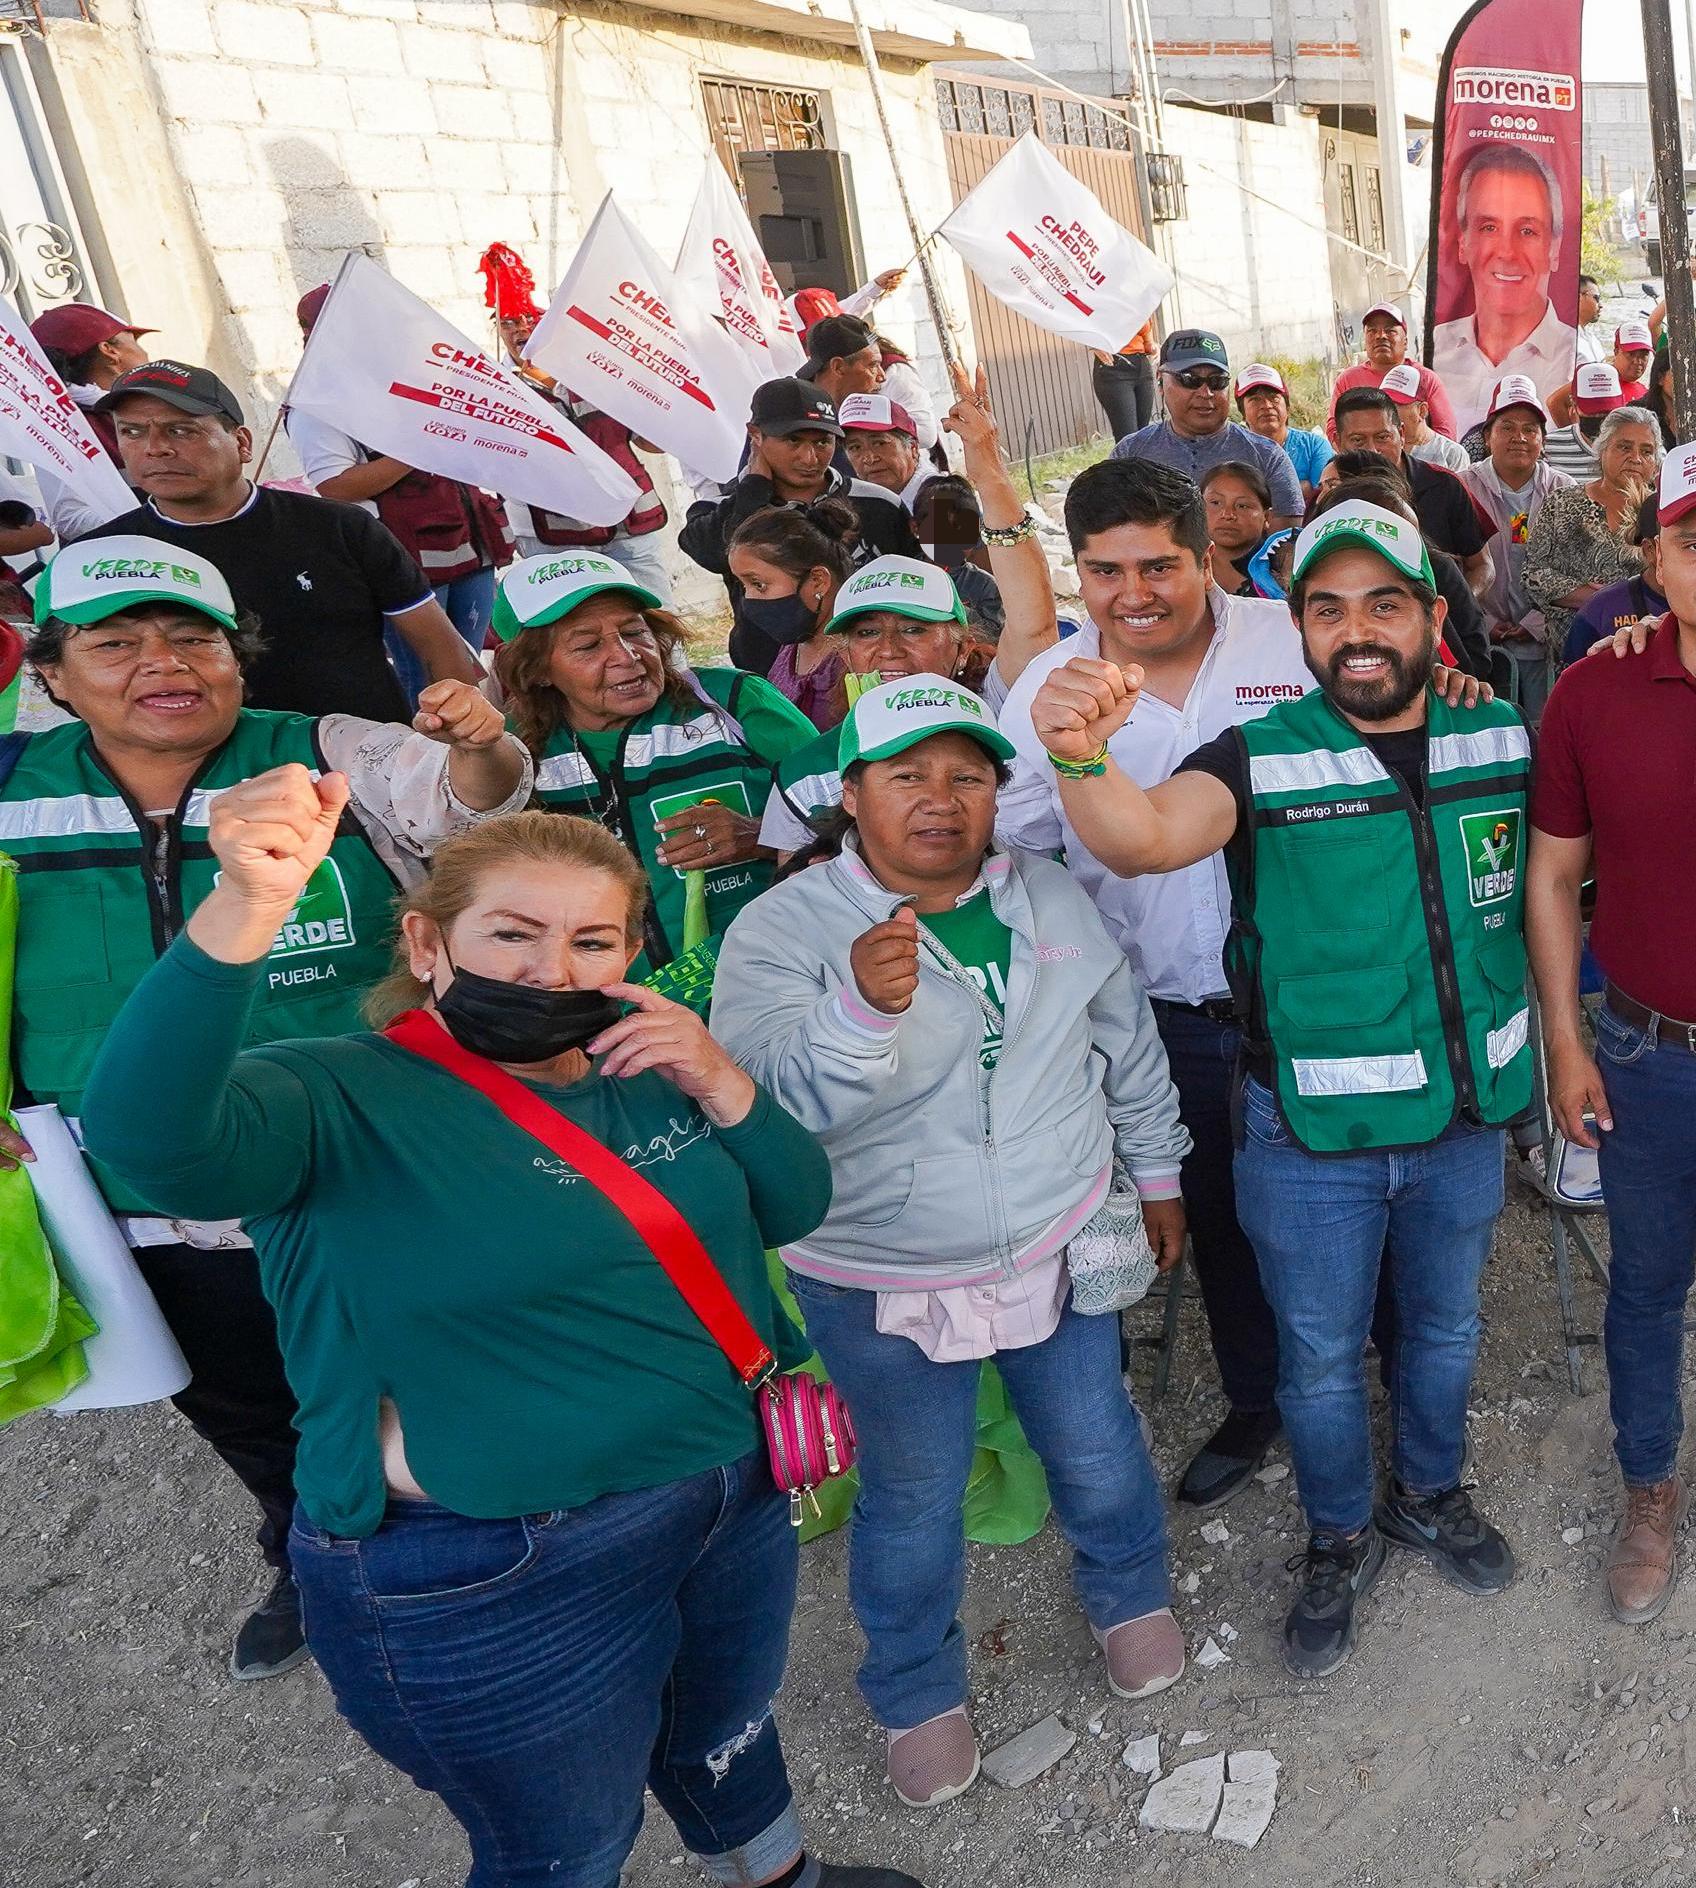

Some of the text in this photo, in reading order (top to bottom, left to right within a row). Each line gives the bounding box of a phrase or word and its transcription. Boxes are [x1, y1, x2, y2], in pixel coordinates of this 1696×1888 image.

[1456, 79, 1570, 105] morena PT
[1469, 129, 1556, 144] @PEPECHEDRAUIMX
[1041, 215, 1106, 286] CHEDRAUI
[1069, 221, 1100, 258] PEPE
[606, 317, 700, 384] POR LA PUEBLA
[587, 352, 623, 379] VOTA
[633, 350, 685, 388] FUTURO
[446, 365, 506, 395] PRESIDENTE
[627, 379, 663, 406] morena
[432, 382, 556, 432] POR LA PUEBLA
[439, 397, 539, 437] DEL FUTURO
[26, 424, 66, 466] morena
[423, 423, 468, 442] VOTA
[473, 438, 517, 456] morena
[1315, 517, 1375, 539] VERDE
[82, 558, 170, 577] VERDE
[95, 571, 161, 581] PUEBLA
[528, 558, 586, 584] VERDE
[538, 567, 586, 585] PUEBLA
[850, 571, 901, 593] VERDE
[853, 580, 892, 595] PUEBLA
[885, 688, 957, 709] VERDE
[1236, 684, 1304, 699] morena
[897, 699, 952, 712] PUEBLA
[1286, 801, 1370, 821] Rodrigo Durán
[703, 871, 753, 897] PUEBLA
[1473, 868, 1515, 899] VERDE
[1484, 911, 1506, 931] PUEBLA
[268, 963, 337, 990] PUEBLA
